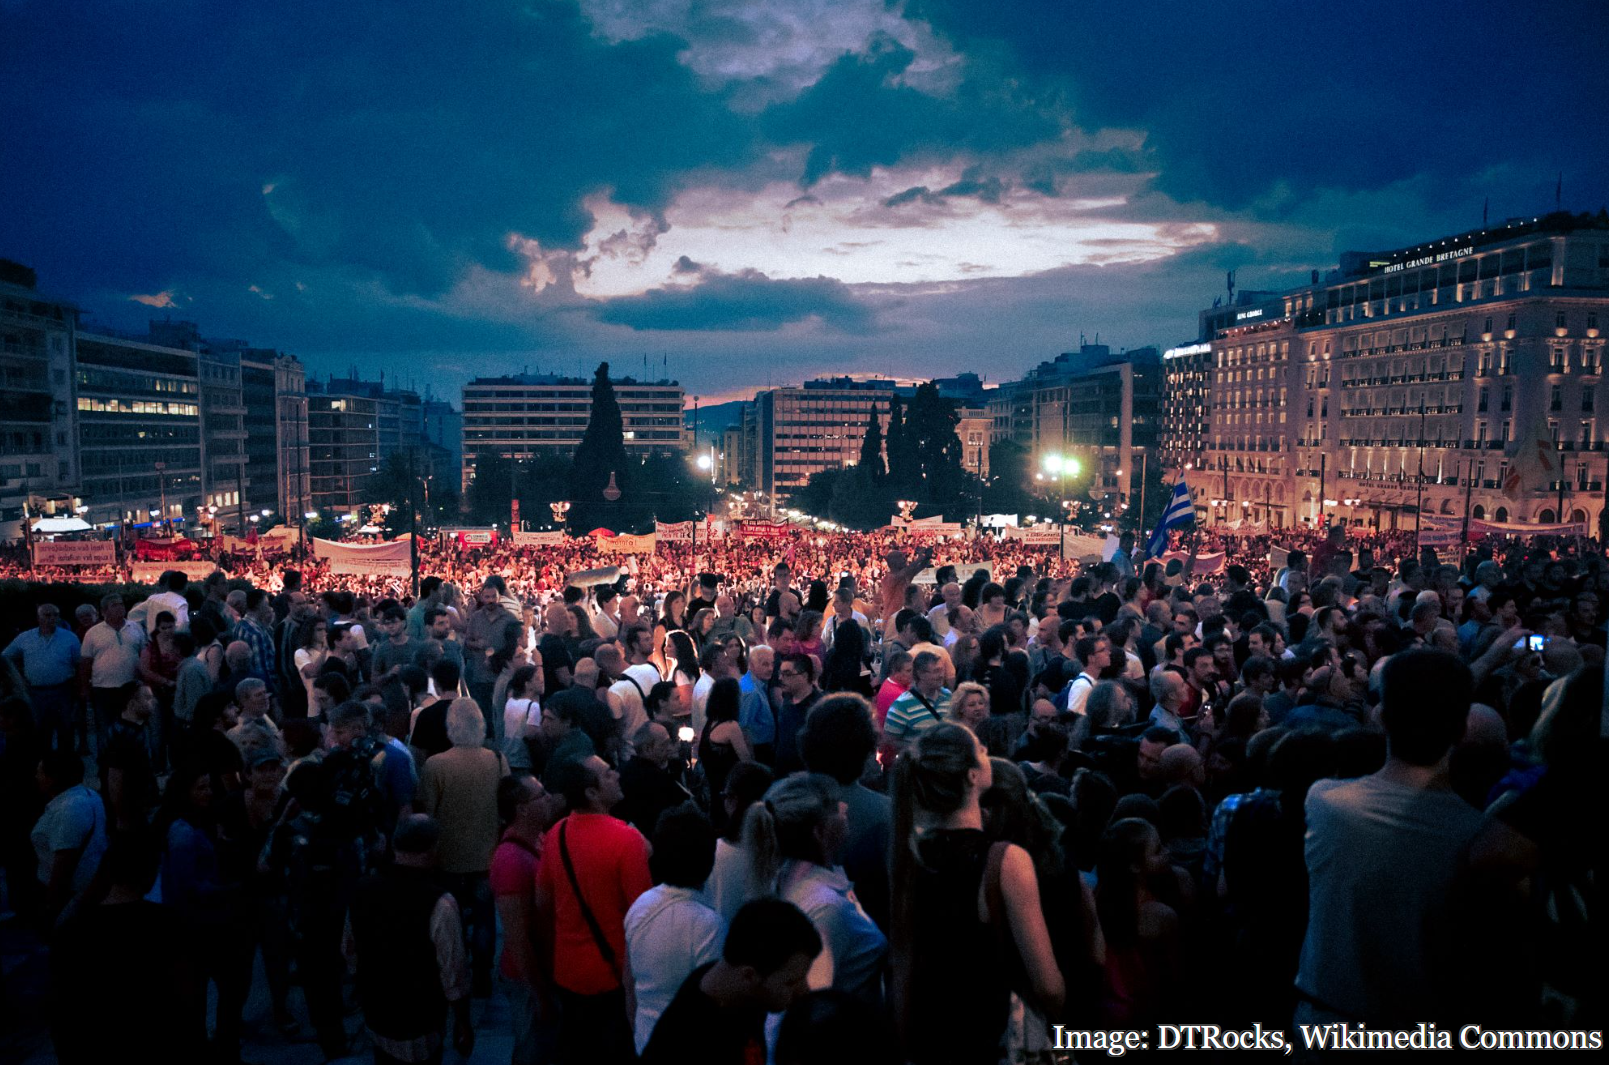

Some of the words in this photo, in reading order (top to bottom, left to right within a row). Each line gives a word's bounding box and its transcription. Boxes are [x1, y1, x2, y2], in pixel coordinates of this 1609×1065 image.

[1384, 262, 1404, 273] HOTEL
[1406, 256, 1433, 269] GRANDE
[1436, 246, 1474, 262] BRETAGNE
